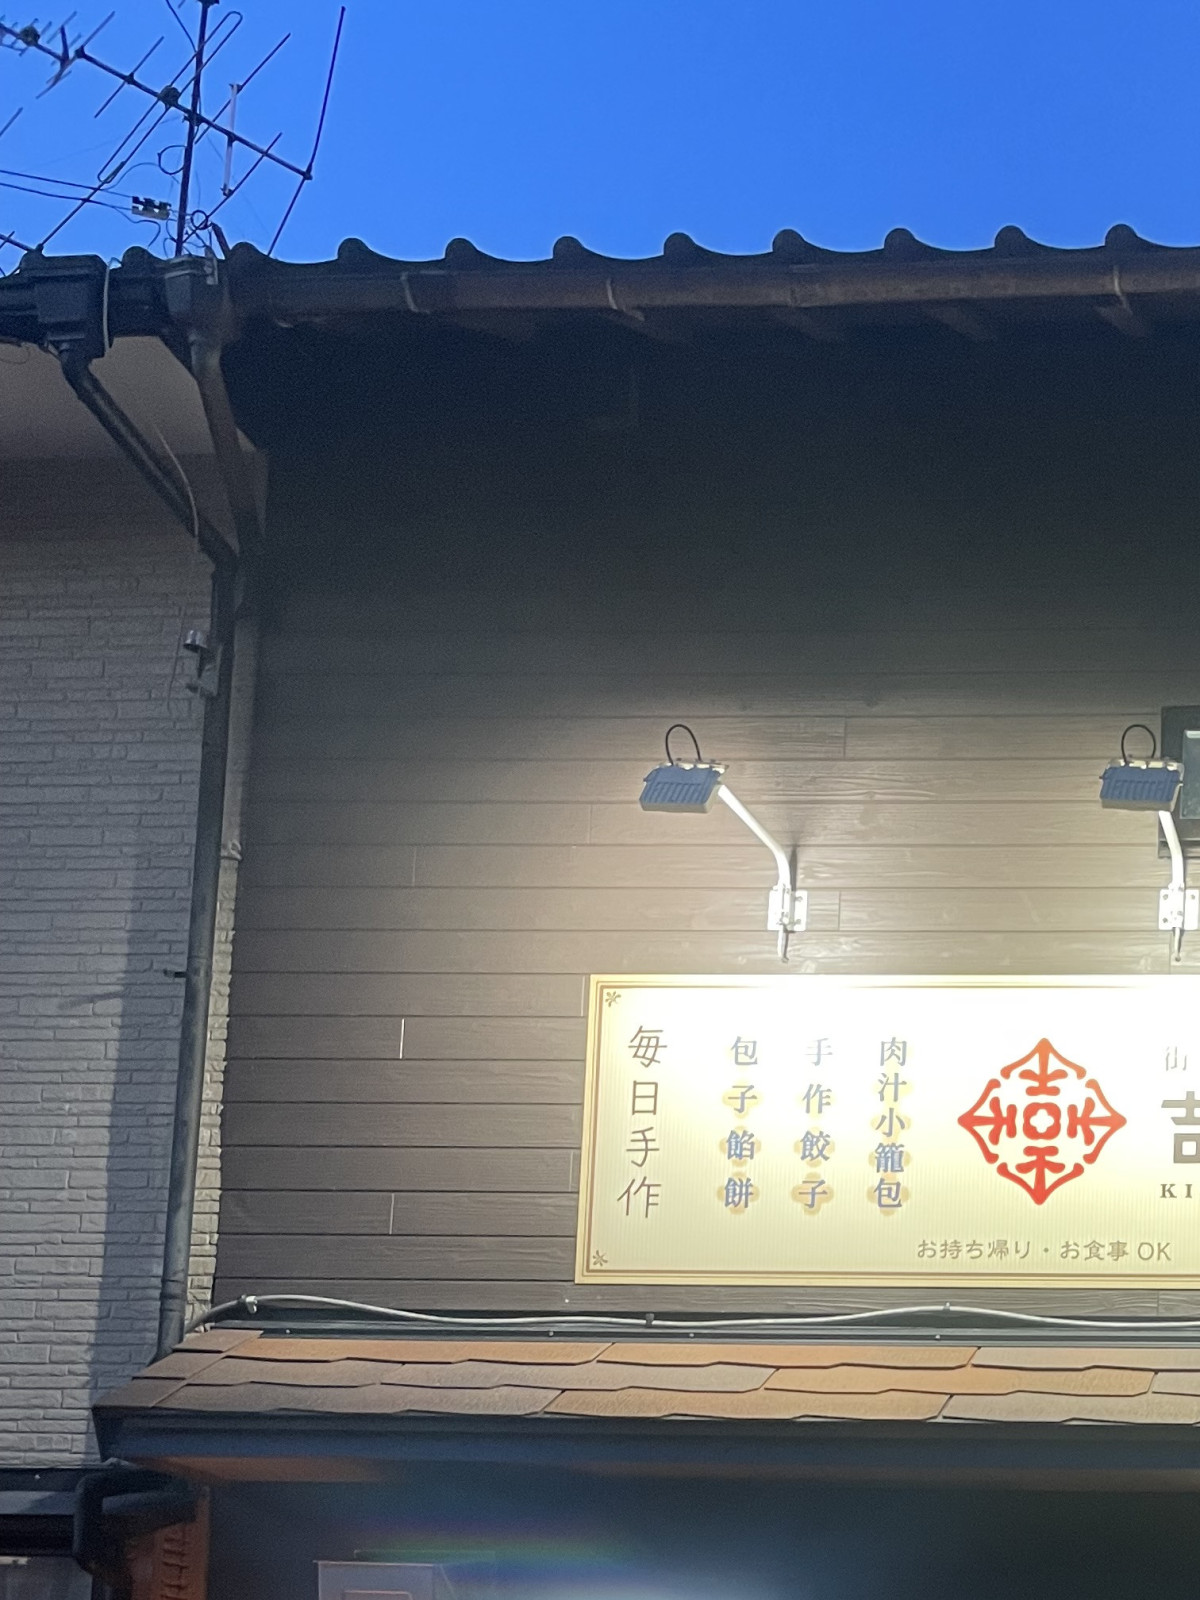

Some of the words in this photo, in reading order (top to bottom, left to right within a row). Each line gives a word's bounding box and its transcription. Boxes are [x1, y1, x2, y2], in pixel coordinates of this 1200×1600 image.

[617, 1025, 668, 1218] 毎日手作
[724, 1035, 758, 1208] 包子餡餅
[799, 1037, 833, 1209] 手作餃子
[873, 1036, 908, 1208] 肉汁小籠包
